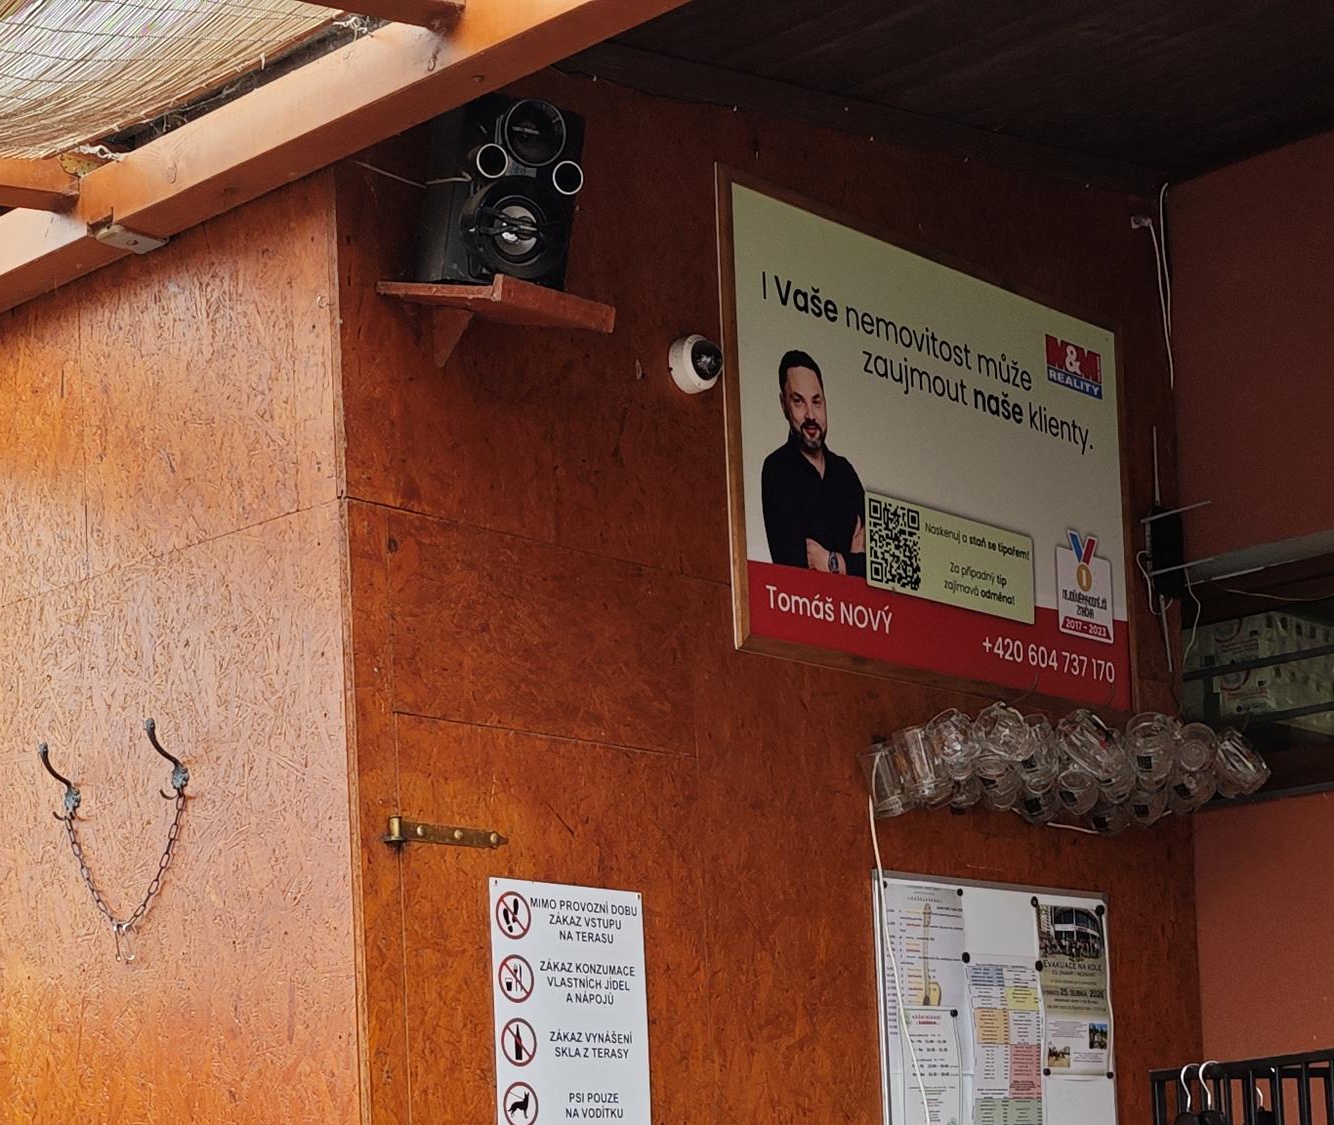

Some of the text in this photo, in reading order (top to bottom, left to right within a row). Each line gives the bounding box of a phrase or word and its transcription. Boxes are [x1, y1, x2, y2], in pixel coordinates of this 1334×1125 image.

[774, 275, 838, 322] Vaše
[845, 303, 972, 370] nemovitost
[977, 352, 1032, 391] může
[1048, 368, 1100, 396] REALITY
[863, 350, 1094, 455] zaujmout naše klienty.
[925, 522, 961, 544] Naskenuj
[988, 541, 997, 551] se
[950, 562, 1007, 588] Za případný tip
[981, 589, 1015, 605] odměna!
[766, 584, 893, 634] Tomáš NOVÝ
[1066, 618, 1082, 631] 2017
[1088, 624, 1107, 637] 2023
[982, 636, 1115, 683] +420 604 737 170
[530, 897, 637, 916] MIMO PROVOZNÍ DOBU
[549, 912, 621, 930] ZÁKAZ VSTUPU
[559, 930, 613, 944] NA TERASU
[540, 958, 635, 976] ZÁKAZ KONZUMACE
[547, 976, 630, 991] VLASTNÍCH JÍDEL
[566, 993, 573, 1003] A
[550, 1029, 632, 1044] ZÁKAZ VYNÁŠENÍ
[555, 1046, 629, 1059] SKLA Z TERASY
[569, 1092, 619, 1104] PSI POUZE
[566, 1105, 624, 1119] NA VODÍTKU
